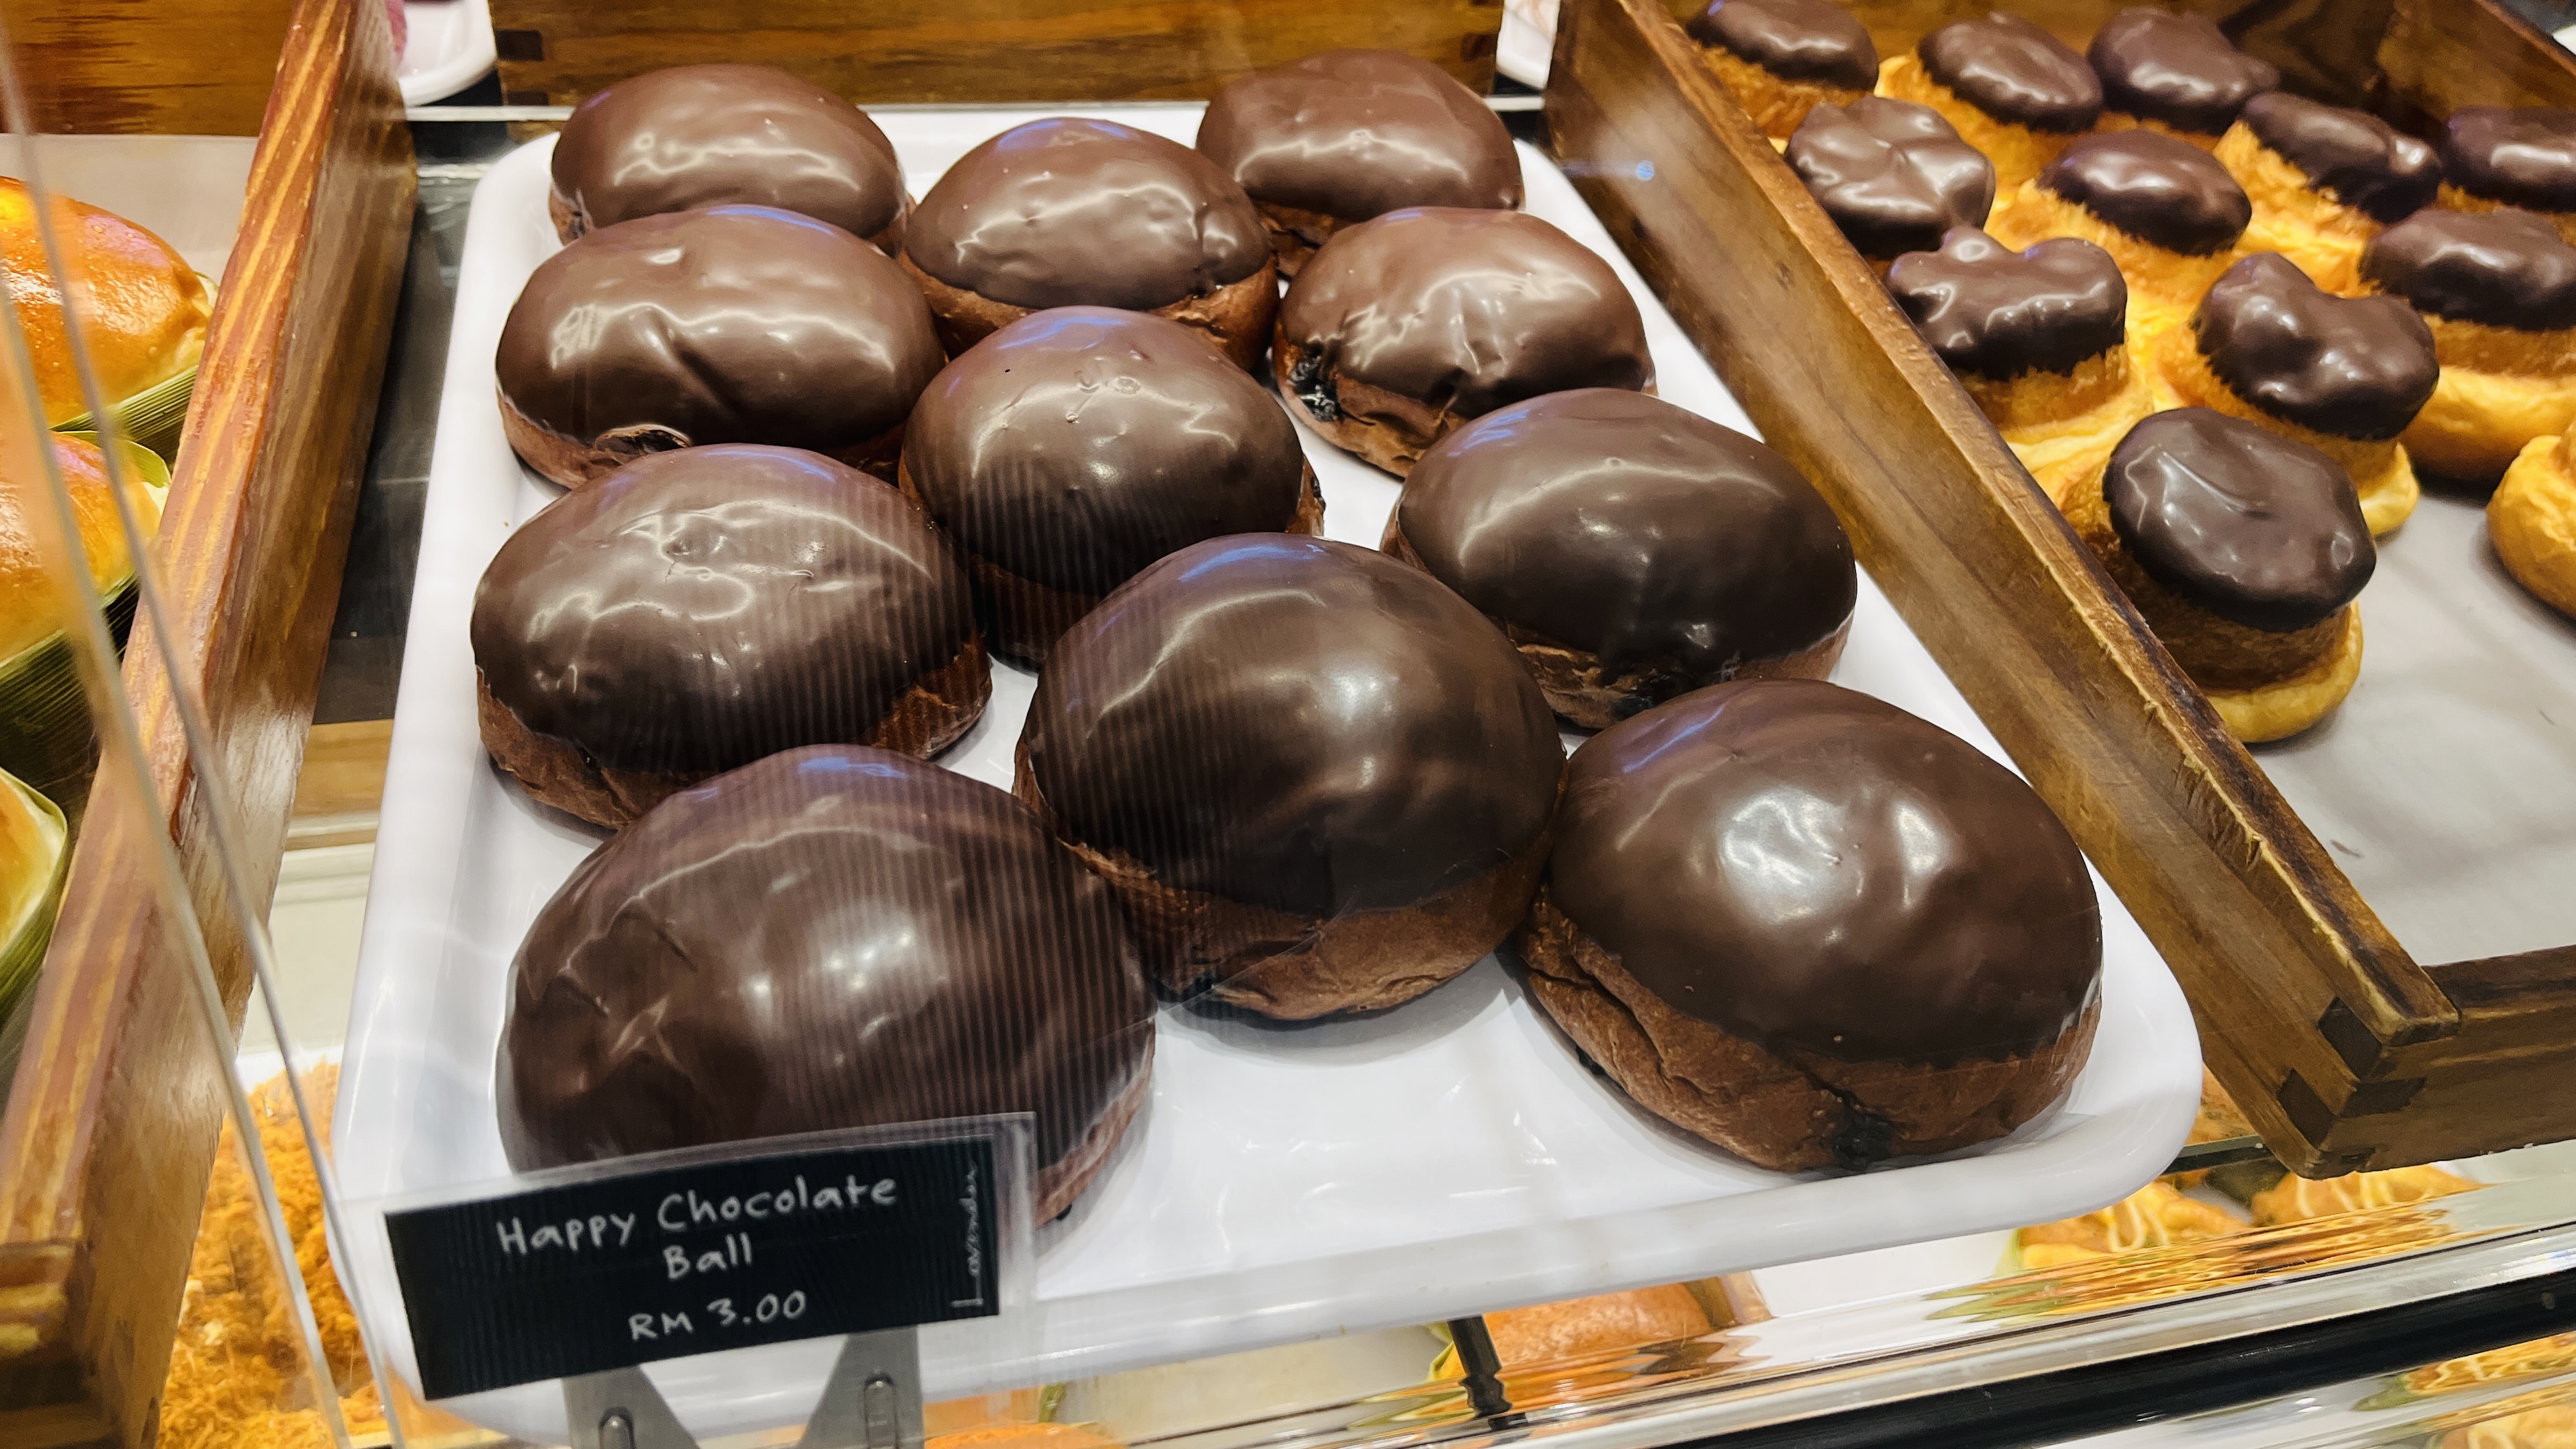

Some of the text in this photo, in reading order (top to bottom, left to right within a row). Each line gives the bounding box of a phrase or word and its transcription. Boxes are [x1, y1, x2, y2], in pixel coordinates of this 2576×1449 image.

[495, 1172, 897, 1257] Happy Chocolate
[662, 1232, 753, 1280] Ball
[628, 1288, 808, 1342] RM 3.00
